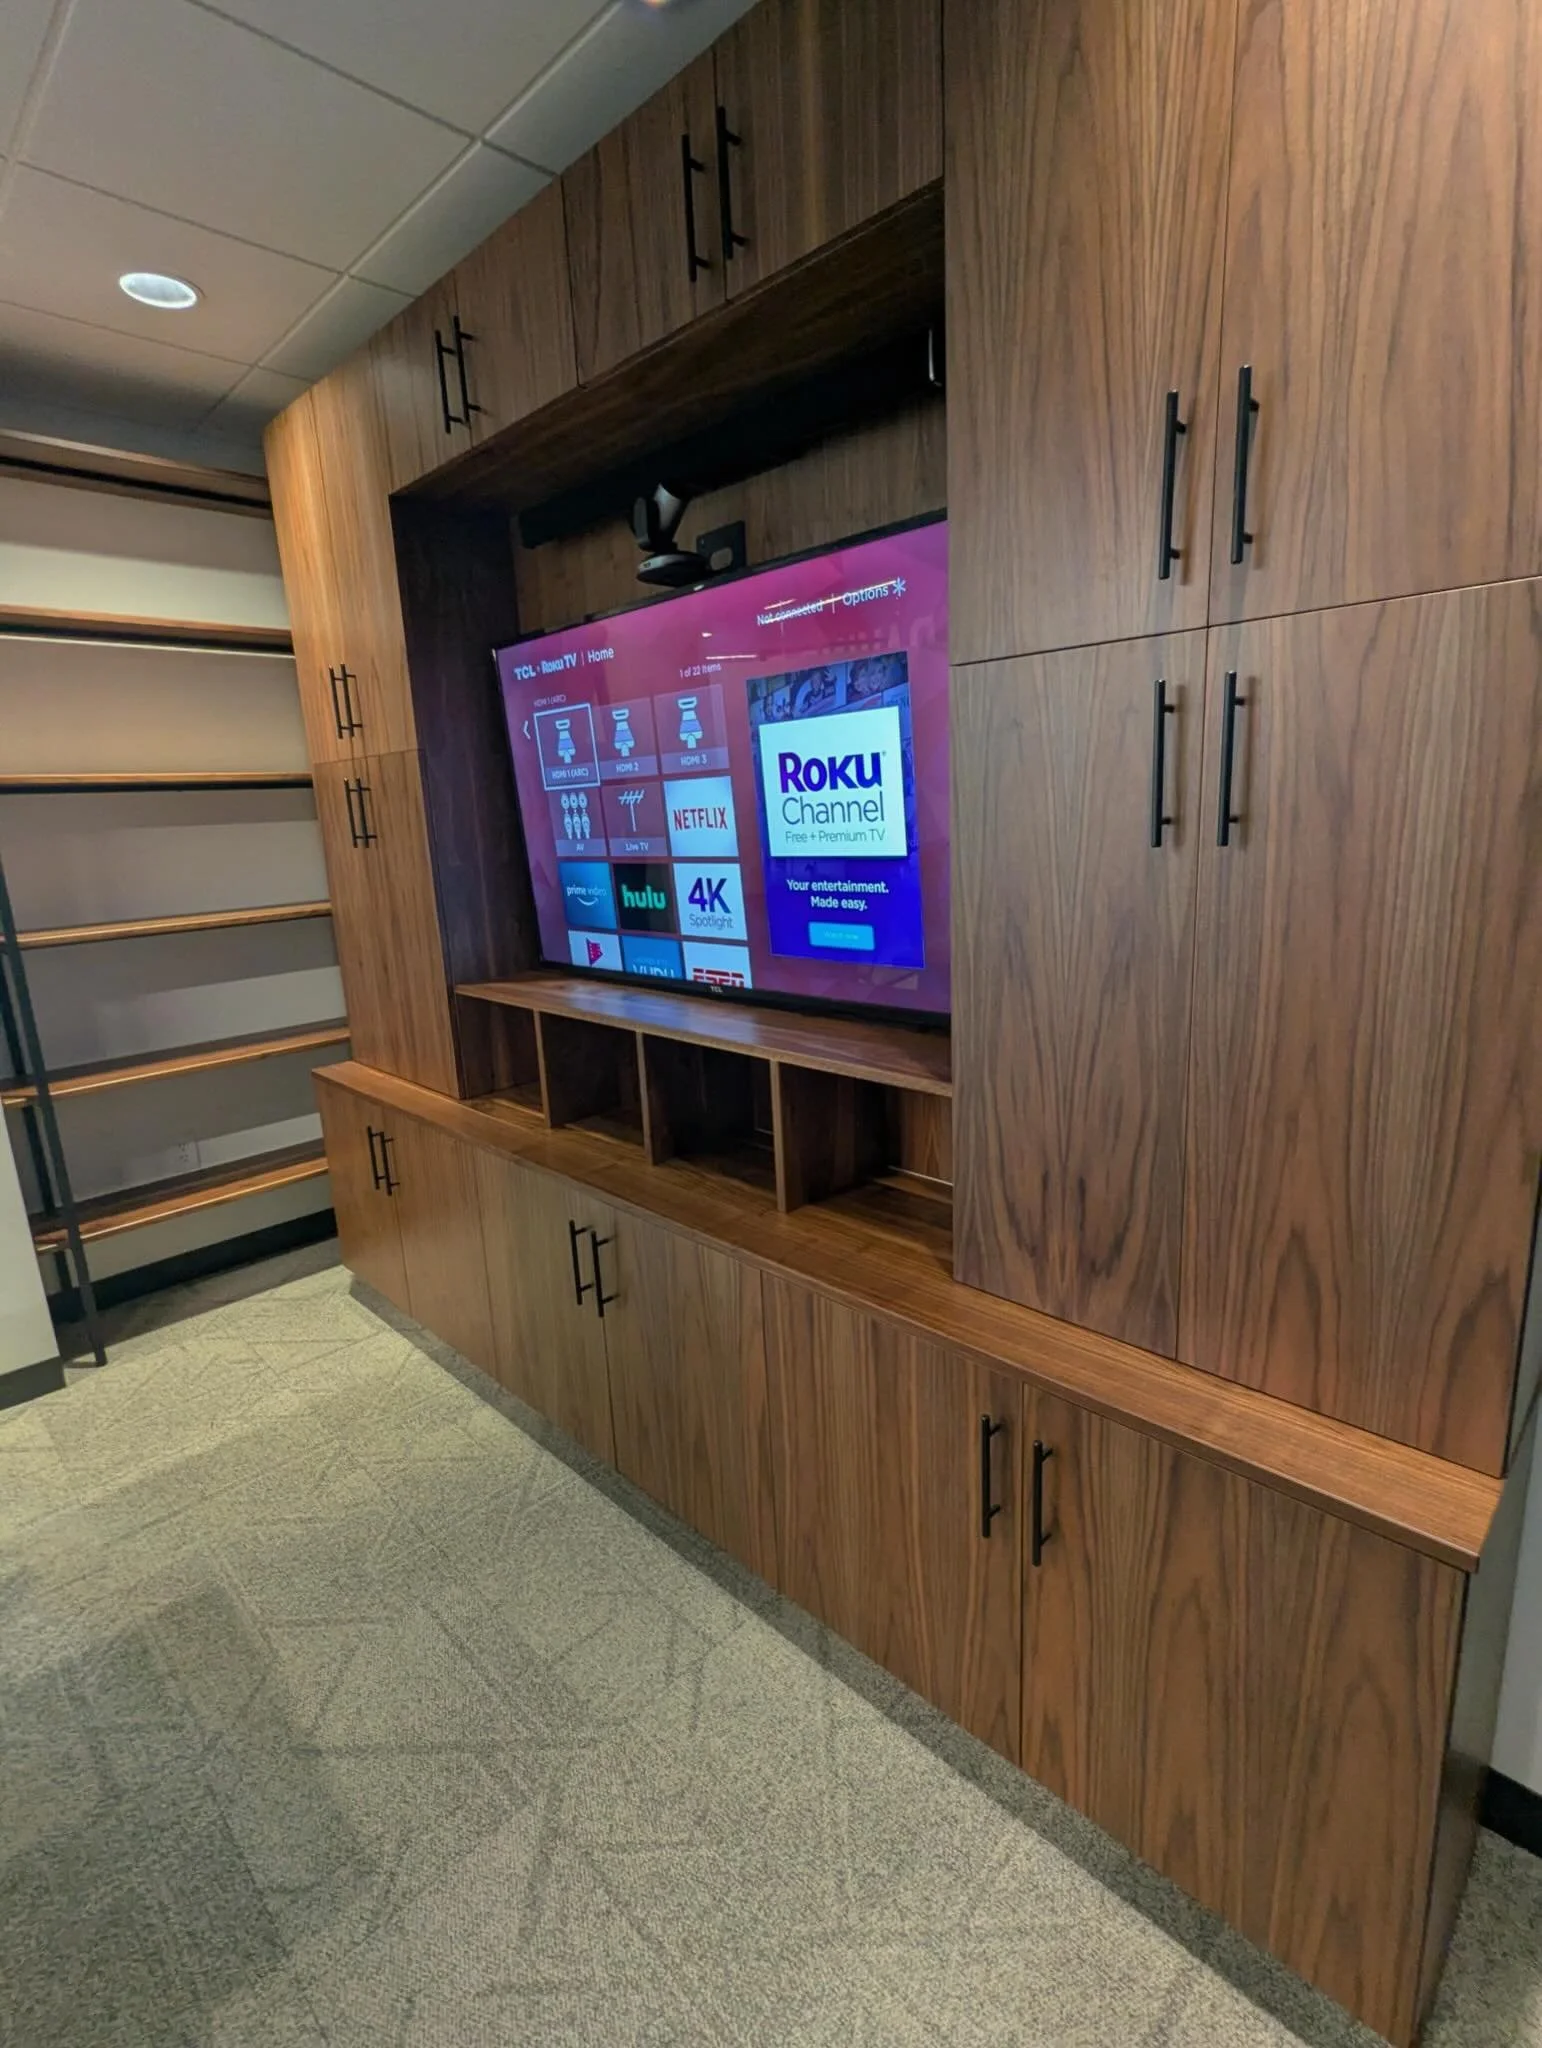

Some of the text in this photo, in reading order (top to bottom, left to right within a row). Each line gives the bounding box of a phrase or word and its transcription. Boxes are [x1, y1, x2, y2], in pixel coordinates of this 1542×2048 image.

[842, 584, 889, 607] Options
[757, 600, 824, 626] Not connected
[587, 647, 615, 663] Home
[514, 664, 537, 681] TCL
[563, 652, 577, 669] TV
[684, 667, 692, 678] of
[692, 666, 702, 677] 22
[616, 762, 640, 773] HDMI 2
[680, 754, 708, 767] HDMI 3
[782, 790, 885, 826] Channel
[673, 807, 728, 832] NETFLIX
[785, 830, 808, 844] Free
[818, 829, 867, 843] Premium
[869, 828, 886, 842] TV
[626, 842, 650, 852] Live TV
[567, 885, 607, 898] prime video
[786, 879, 889, 894] Your entertainment.
[621, 884, 667, 911] hulu
[688, 877, 733, 914] 4K
[810, 896, 868, 911] Made easy.
[688, 913, 734, 931] Spotlight
